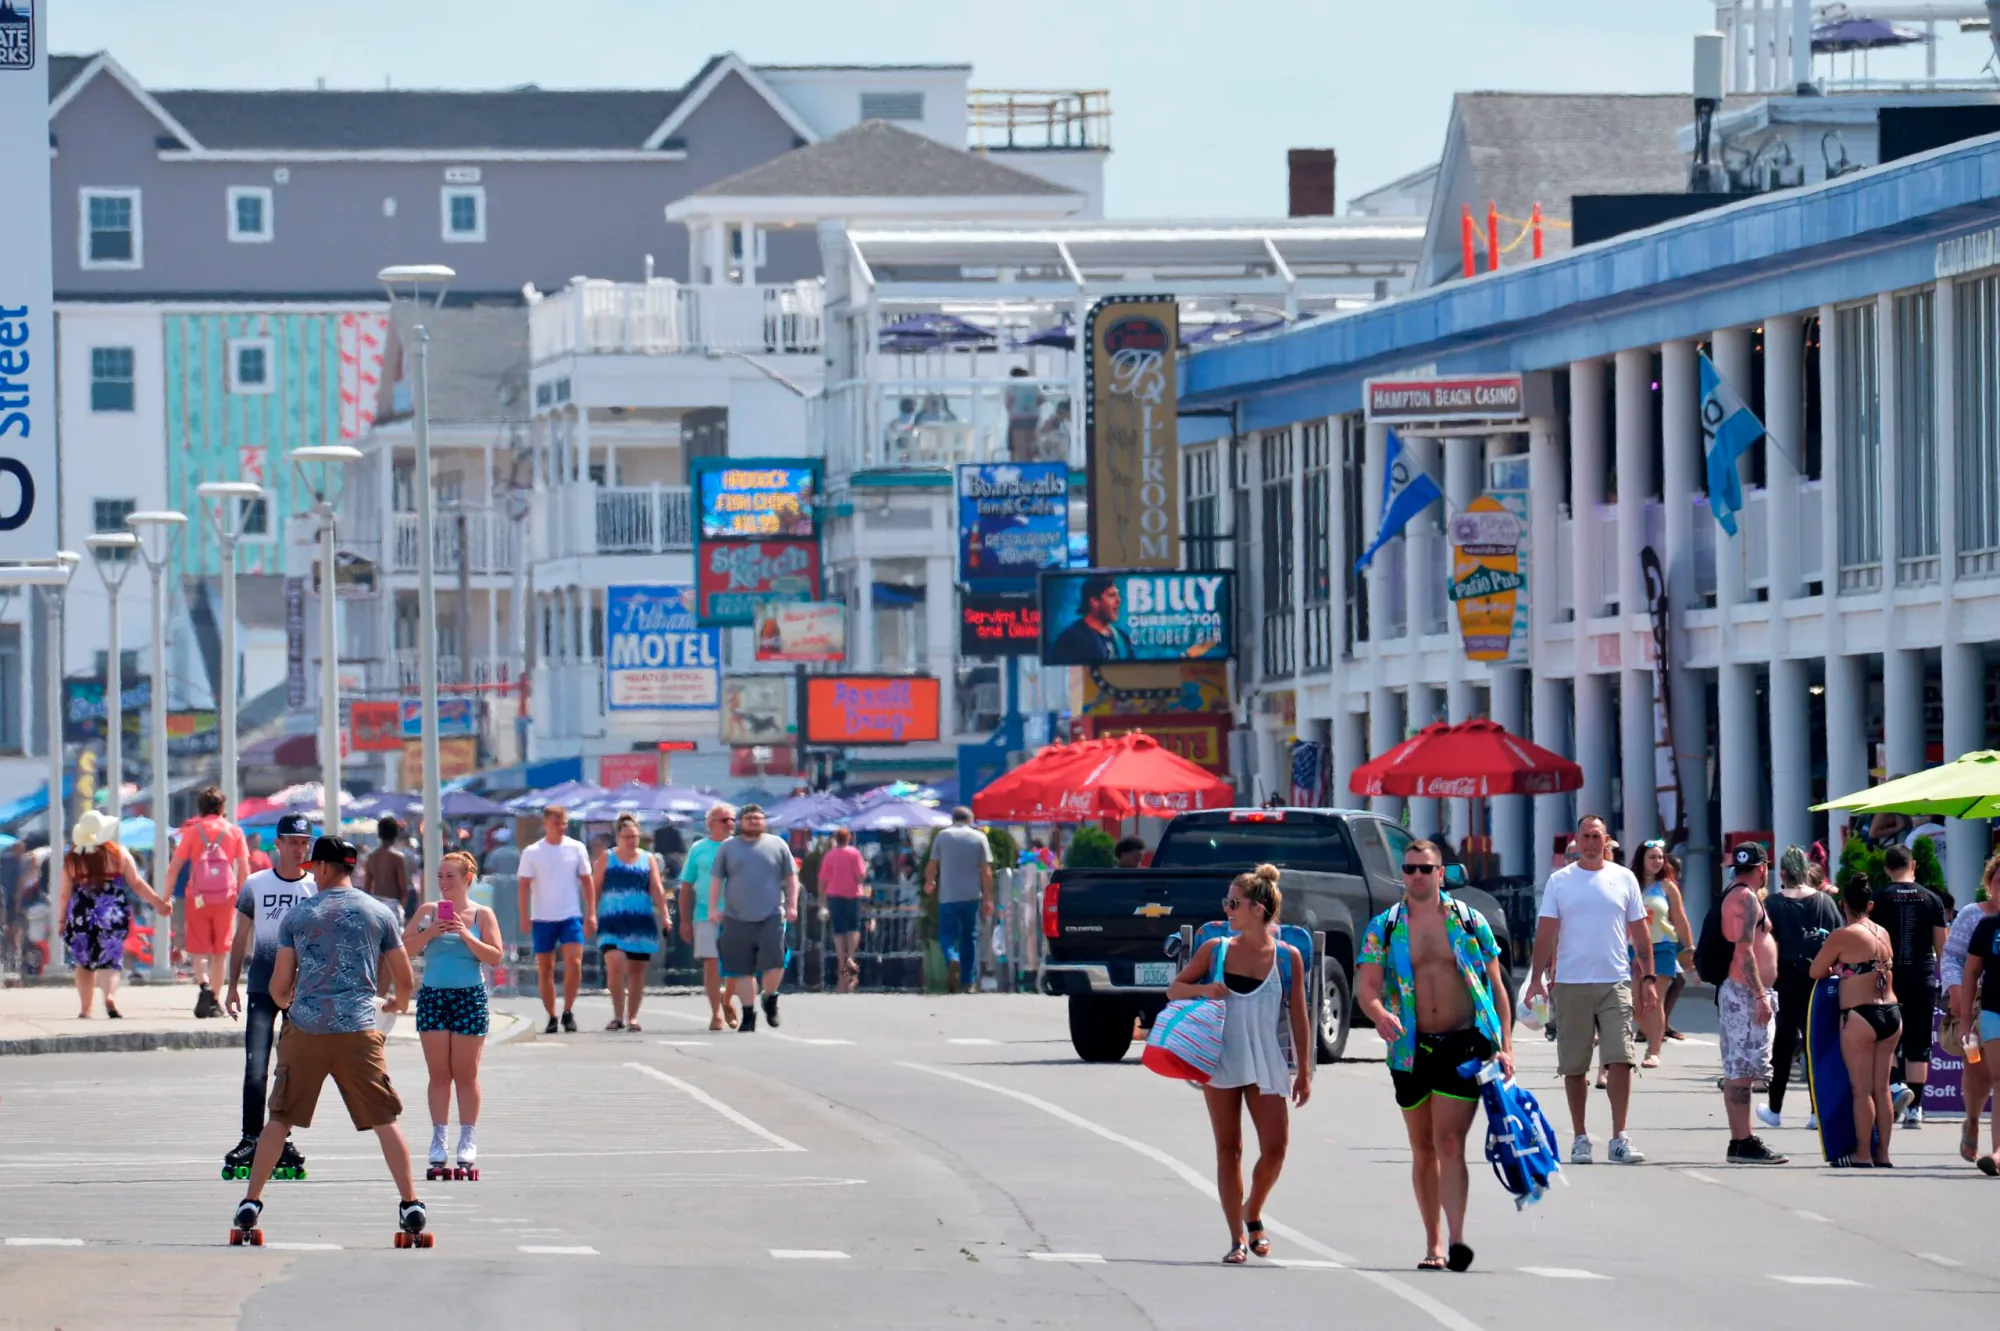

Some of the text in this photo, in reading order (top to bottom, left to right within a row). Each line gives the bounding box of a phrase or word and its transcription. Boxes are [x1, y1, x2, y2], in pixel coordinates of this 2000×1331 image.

[1374, 385, 1518, 409] HAMPTON BEACH CASINO
[1127, 577, 1223, 612] BILLY
[611, 632, 717, 667] MOTEL
[1924, 1084, 1957, 1098] Soft
